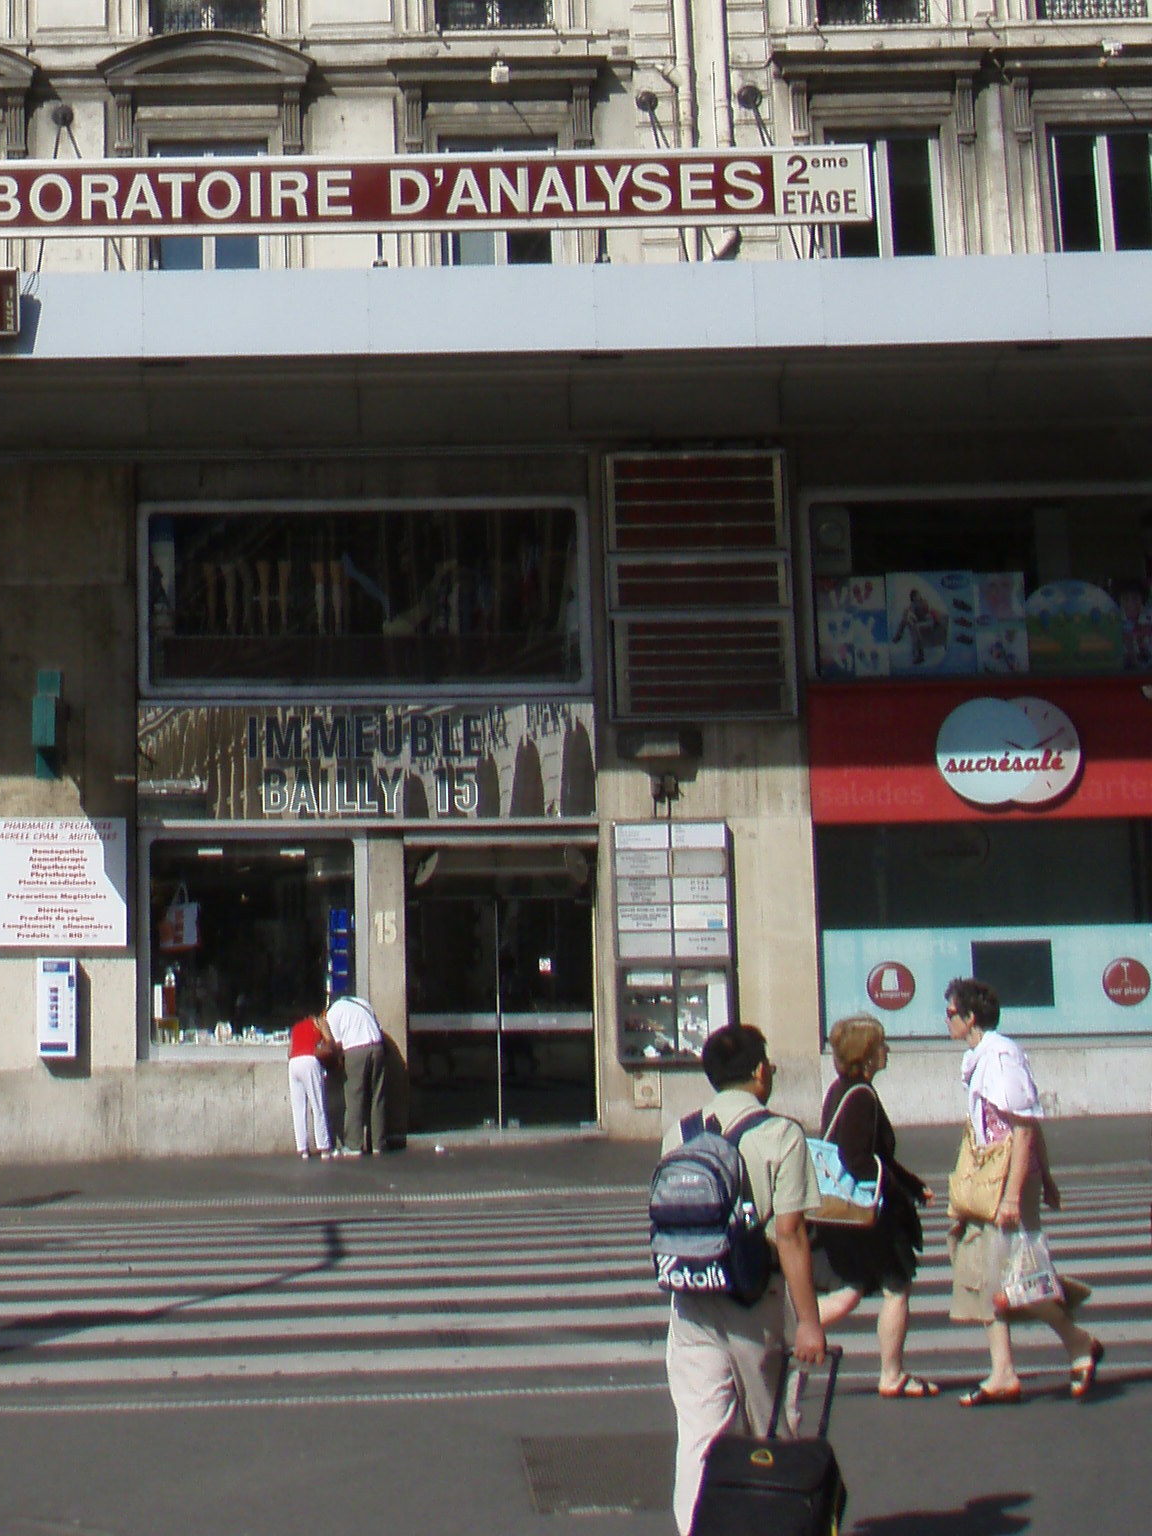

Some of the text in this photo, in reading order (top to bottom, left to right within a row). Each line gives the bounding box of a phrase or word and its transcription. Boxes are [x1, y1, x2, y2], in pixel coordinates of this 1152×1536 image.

[389, 158, 765, 215] D'ANALYSES
[783, 189, 857, 215] ETAGE
[246, 713, 485, 759] IMMEUBLE
[943, 749, 1066, 774] sucrésalé
[261, 766, 480, 815] BAILLY 15
[374, 911, 397, 945] 15
